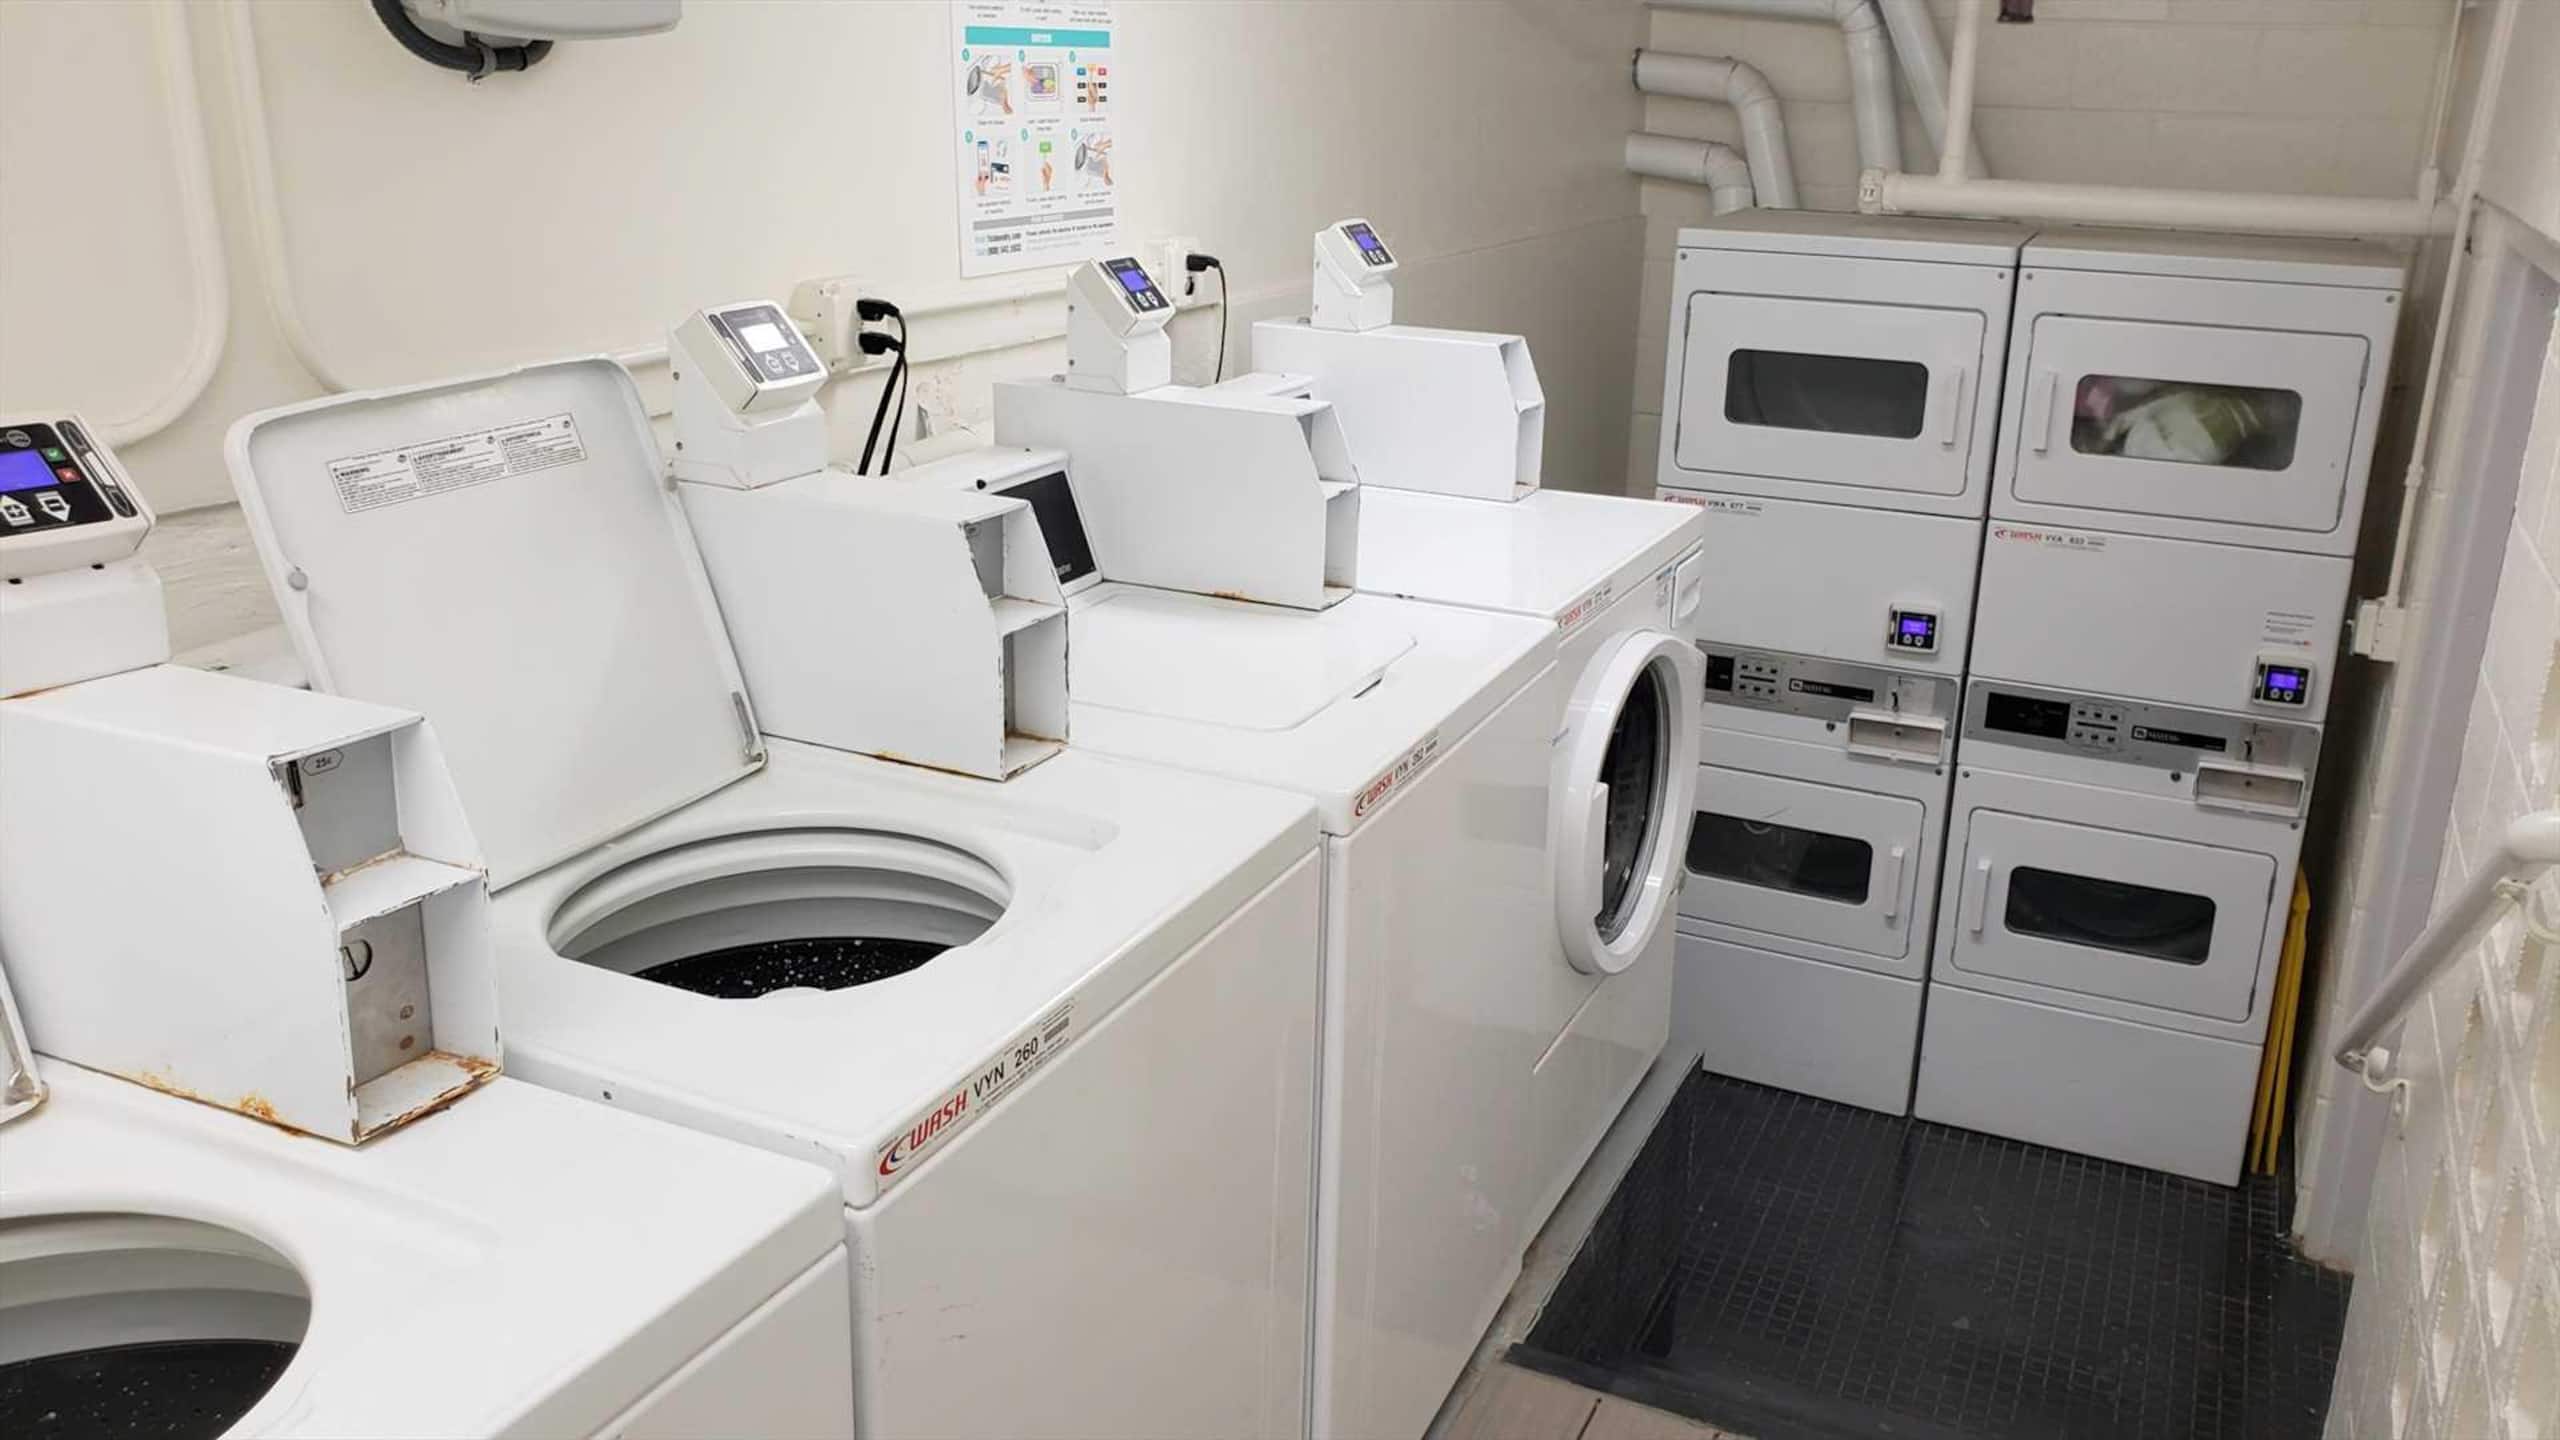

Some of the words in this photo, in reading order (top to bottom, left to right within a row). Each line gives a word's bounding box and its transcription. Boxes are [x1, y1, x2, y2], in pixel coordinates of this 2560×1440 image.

[2009, 530, 2042, 542] WASH
[1367, 770, 1393, 805] WASH
[910, 1089, 968, 1151] WASH
[973, 1061, 1005, 1098] VYN
[1014, 1036, 1039, 1068] 260
